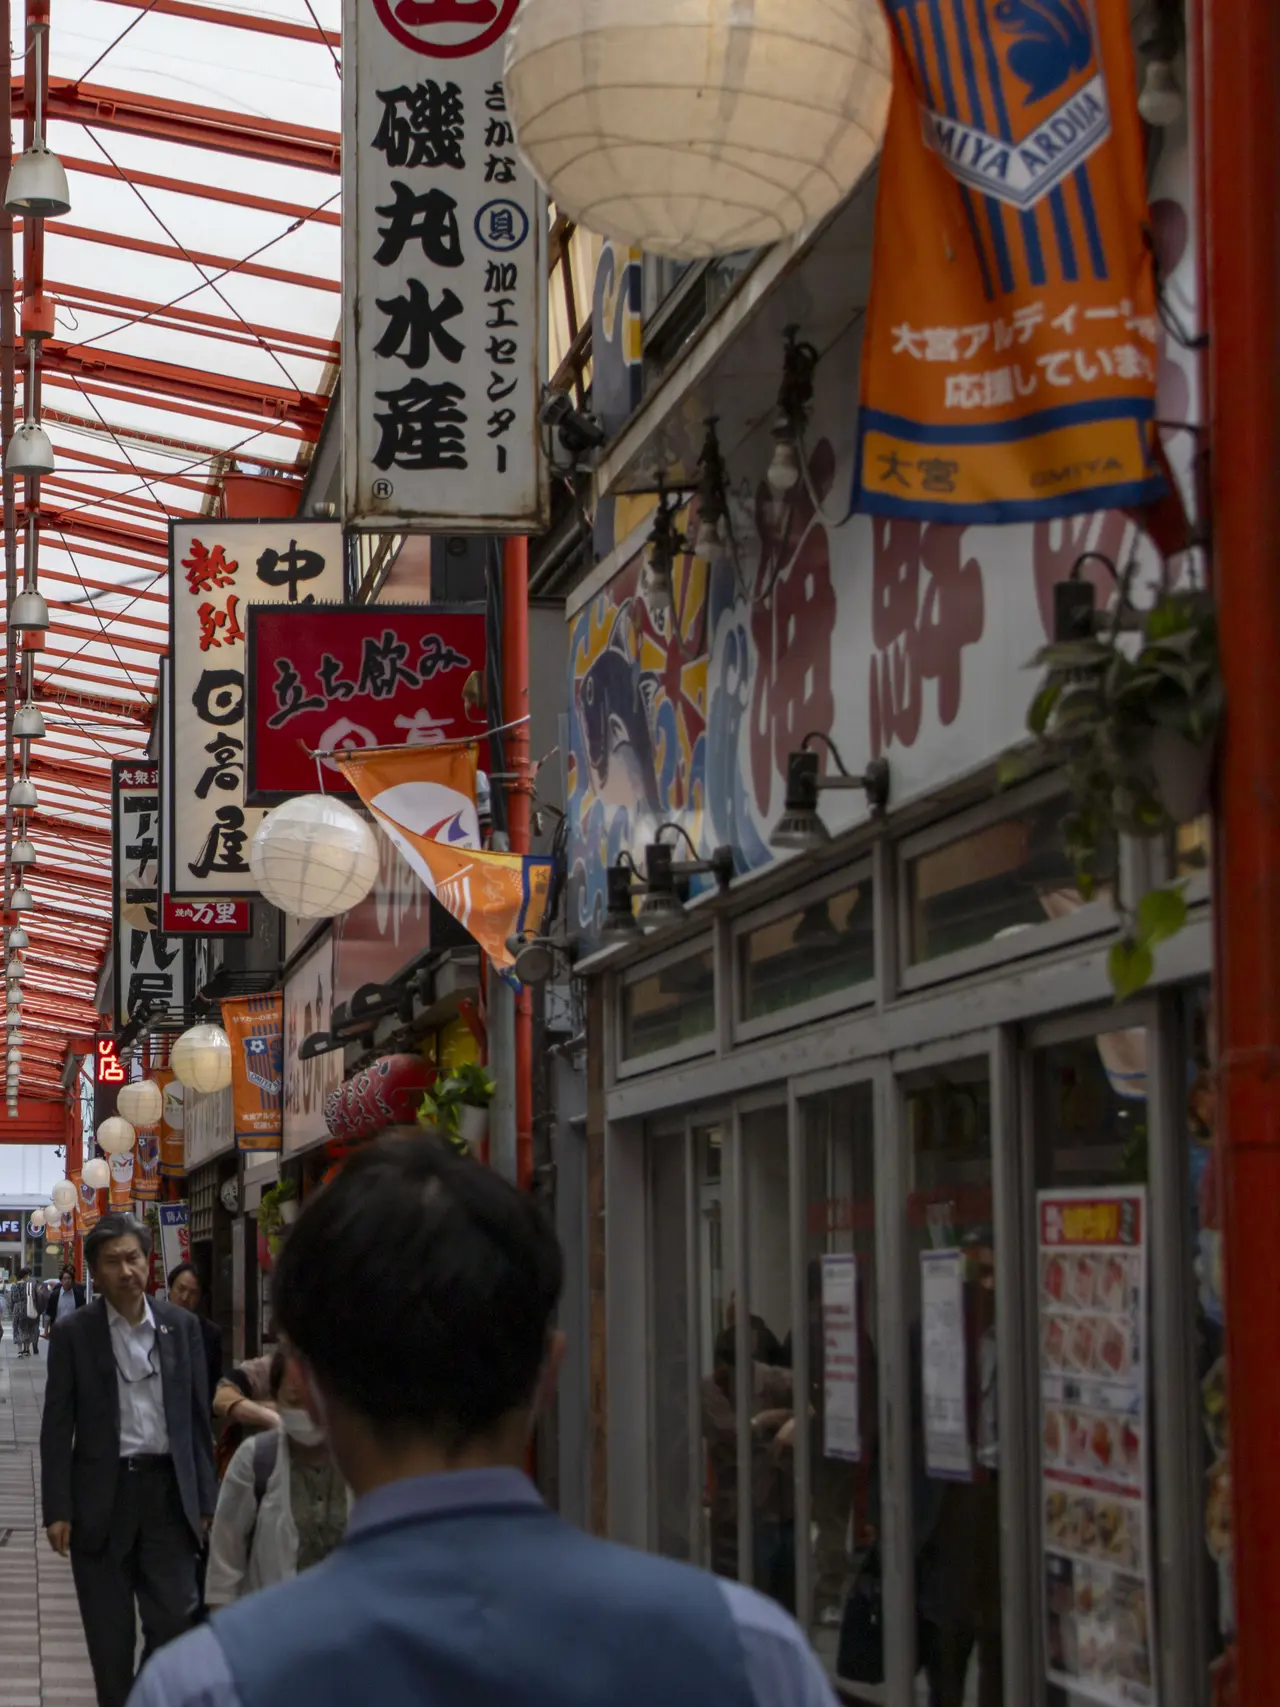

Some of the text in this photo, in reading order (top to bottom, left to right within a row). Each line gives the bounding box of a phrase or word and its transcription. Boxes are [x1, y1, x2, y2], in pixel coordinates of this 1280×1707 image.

[926, 113, 1010, 180] MIYA
[371, 79, 469, 472] 磯丸水産
[890, 297, 1157, 363] 大宮アルディー
[943, 342, 1156, 410] 応援していま
[876, 451, 959, 493] 大宮
[180, 538, 245, 652] 熱烈
[256, 539, 325, 602] 中
[266, 628, 472, 730] 立ち飲み
